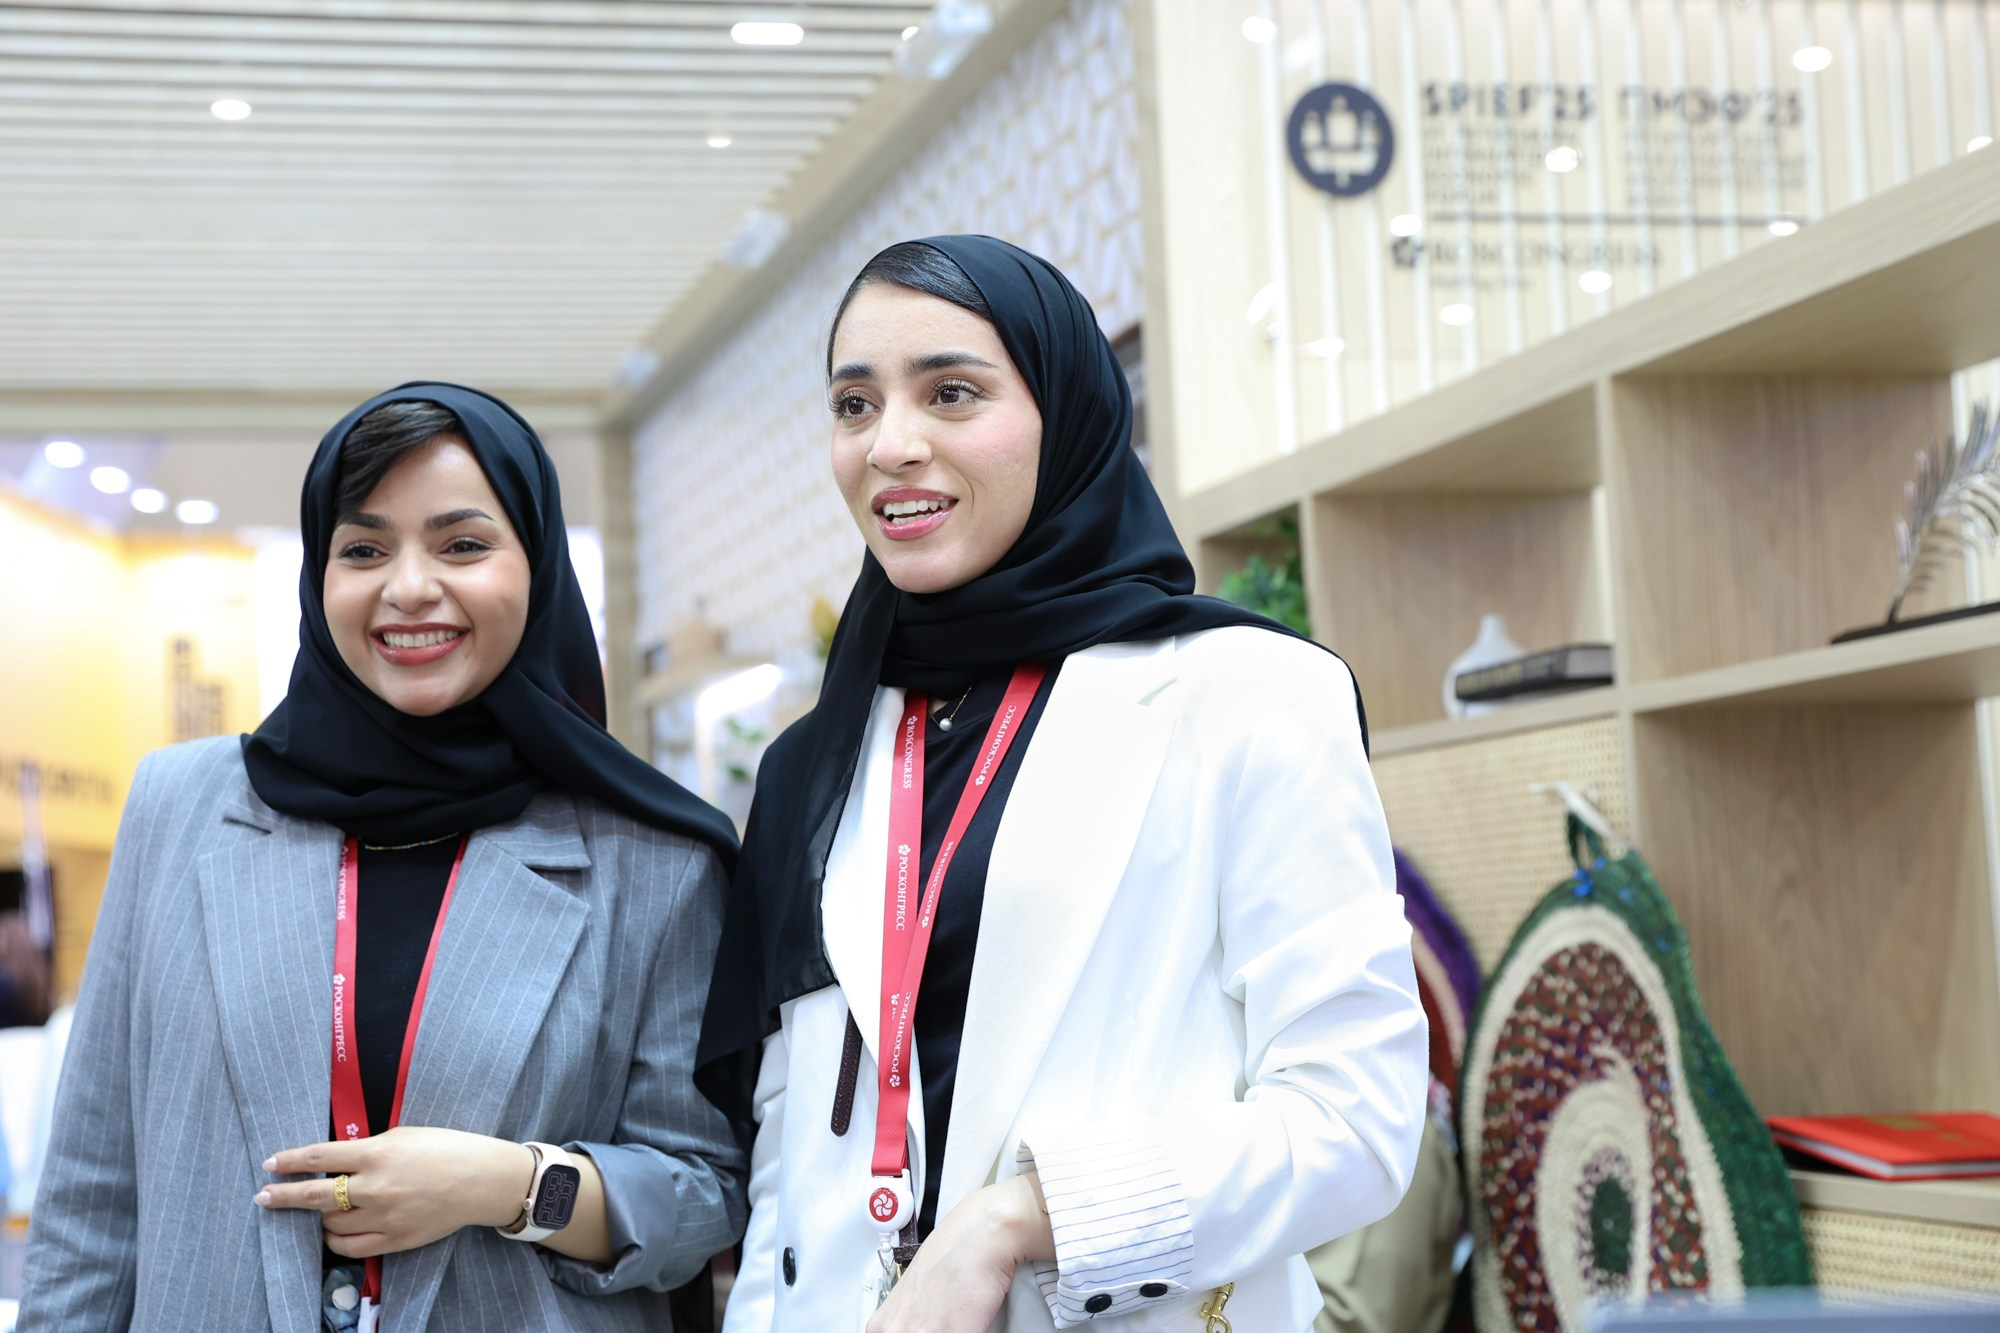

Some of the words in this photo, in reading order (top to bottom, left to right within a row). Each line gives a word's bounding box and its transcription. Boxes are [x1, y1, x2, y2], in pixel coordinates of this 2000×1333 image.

[903, 726, 915, 789] ROSCONGRESS
[980, 705, 1017, 775] РОСКОНГРЕСС
[896, 856, 908, 931] РОСКОНГРЕСС
[925, 841, 954, 915] ROSCONGRESS
[334, 986, 347, 1062] РОСКОНГРЕСС
[891, 992, 912, 1073] РОСКОНГРЕСС
